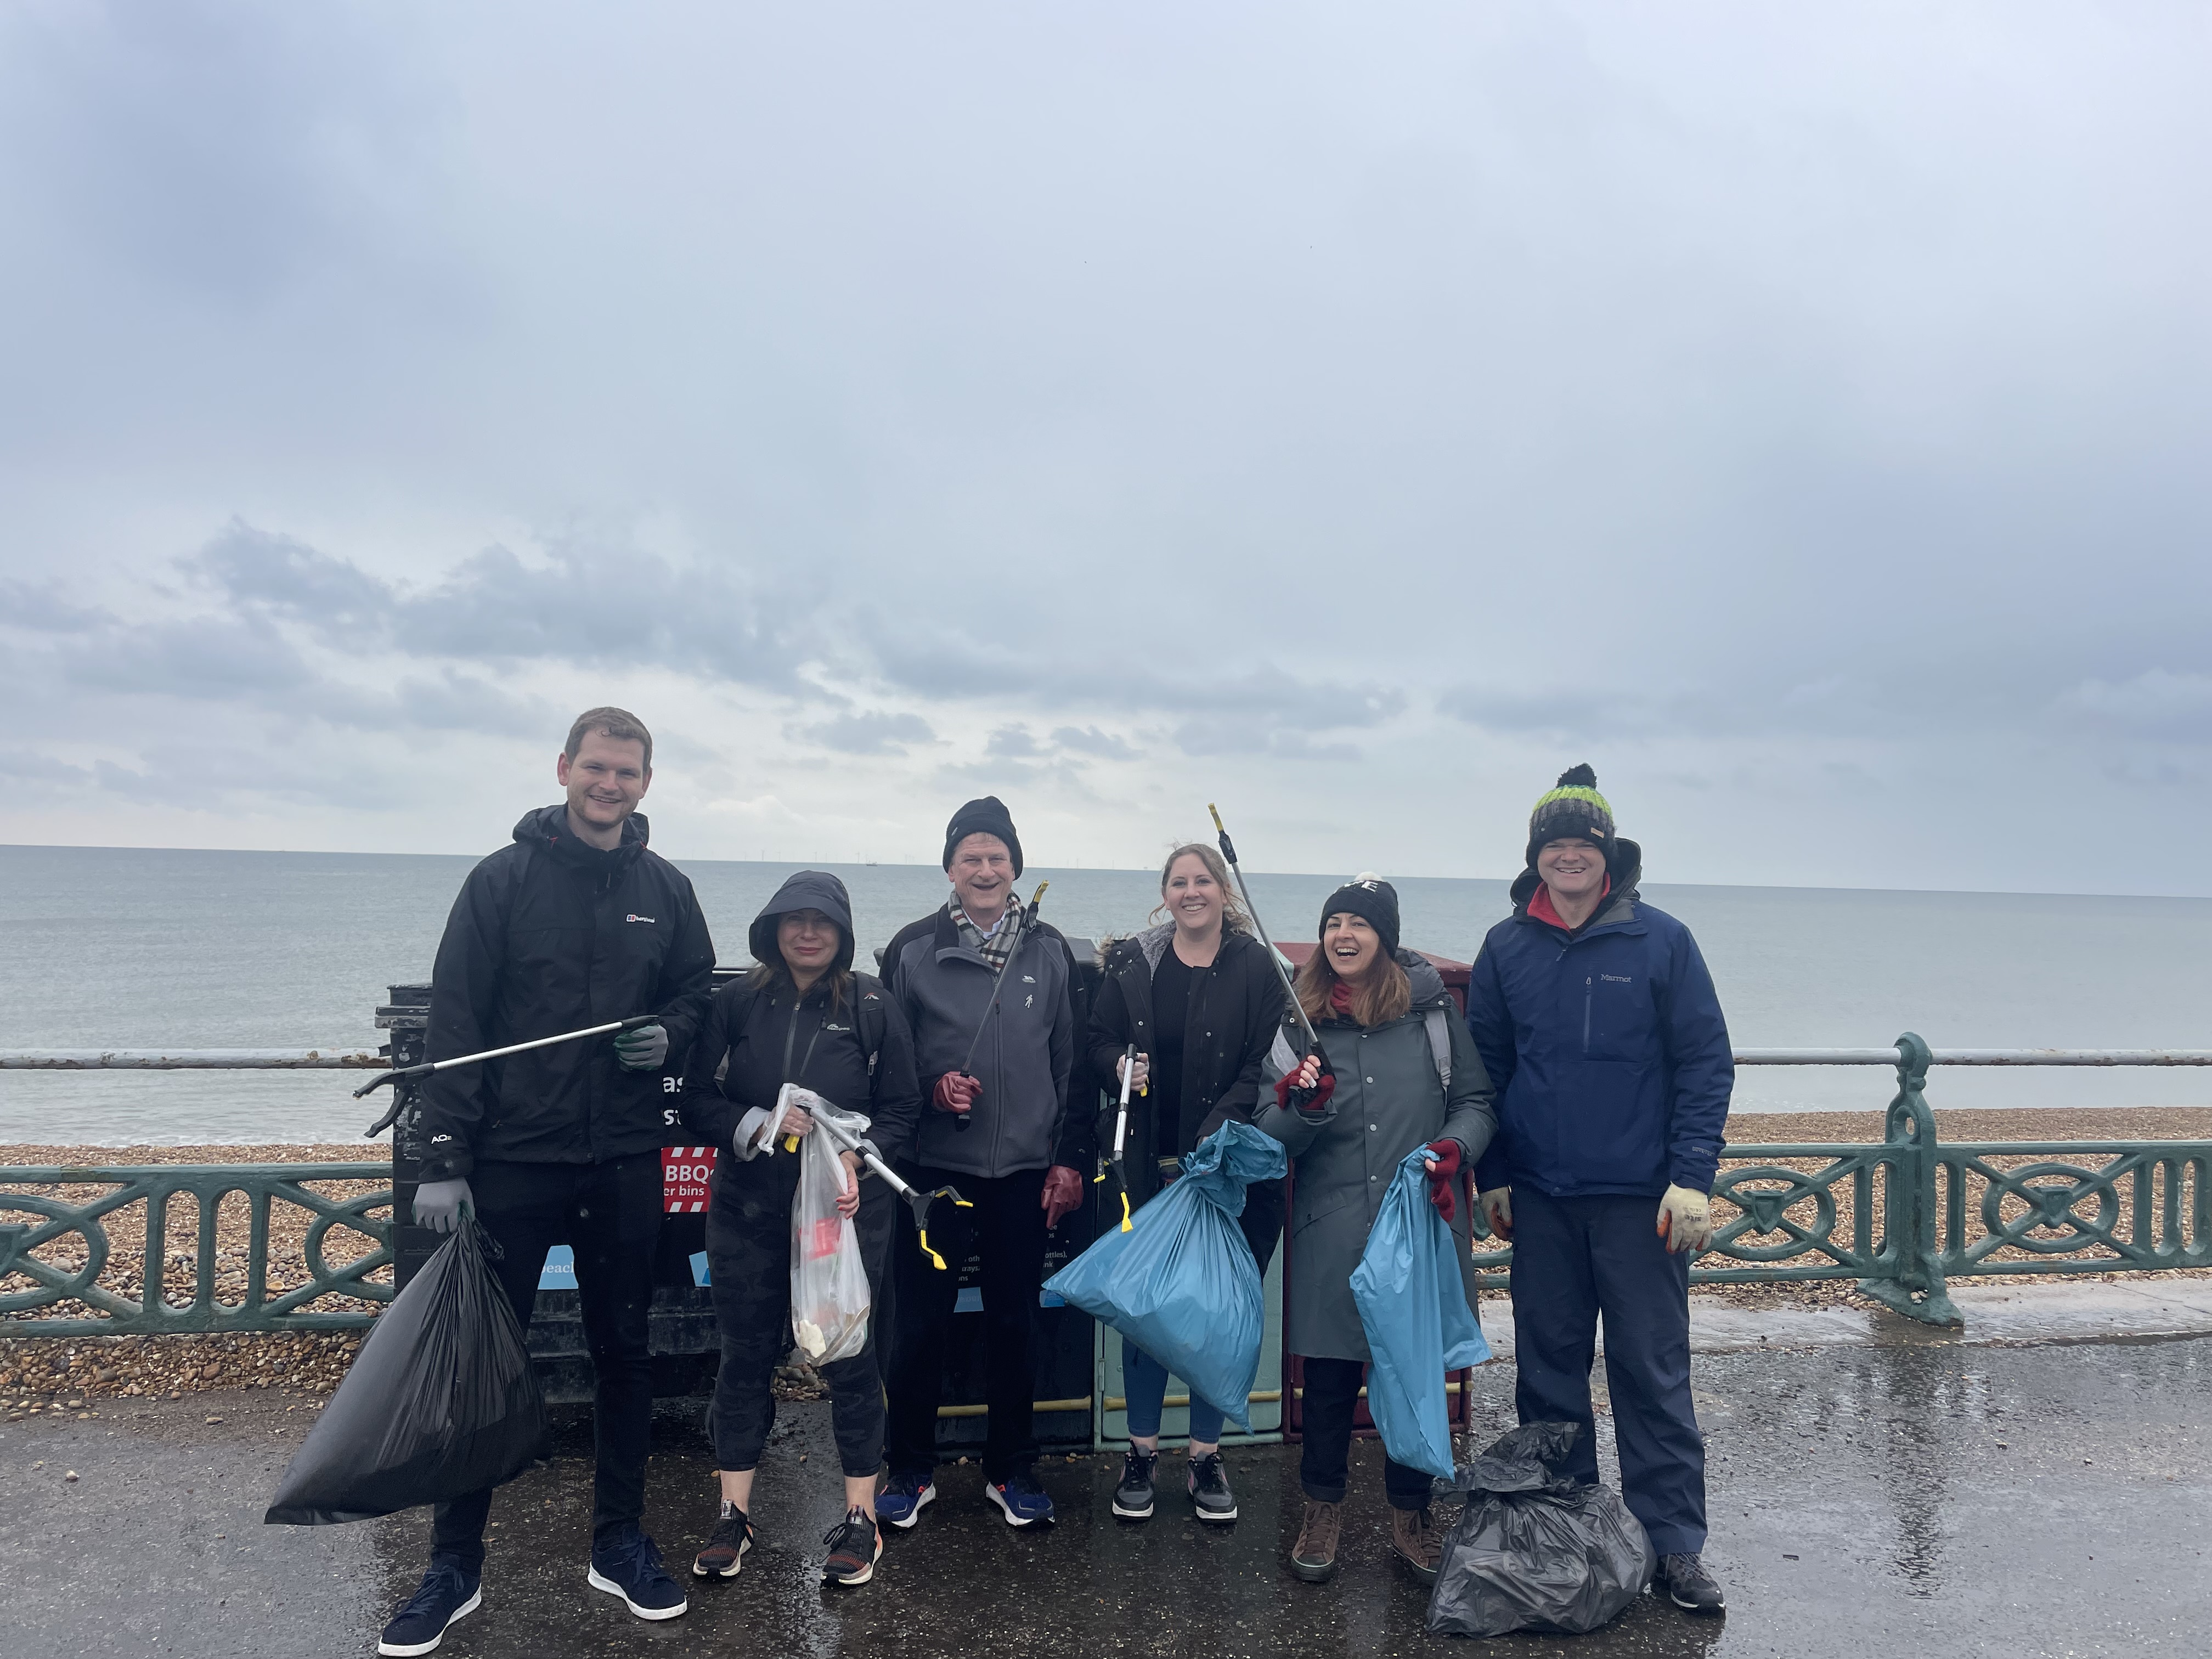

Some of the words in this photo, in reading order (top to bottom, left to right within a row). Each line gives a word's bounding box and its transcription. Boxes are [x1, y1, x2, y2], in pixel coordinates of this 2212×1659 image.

[1600, 973, 1632, 983] Marmot
[665, 1164, 714, 1184] BBQ
[679, 1185, 705, 1196] bins
